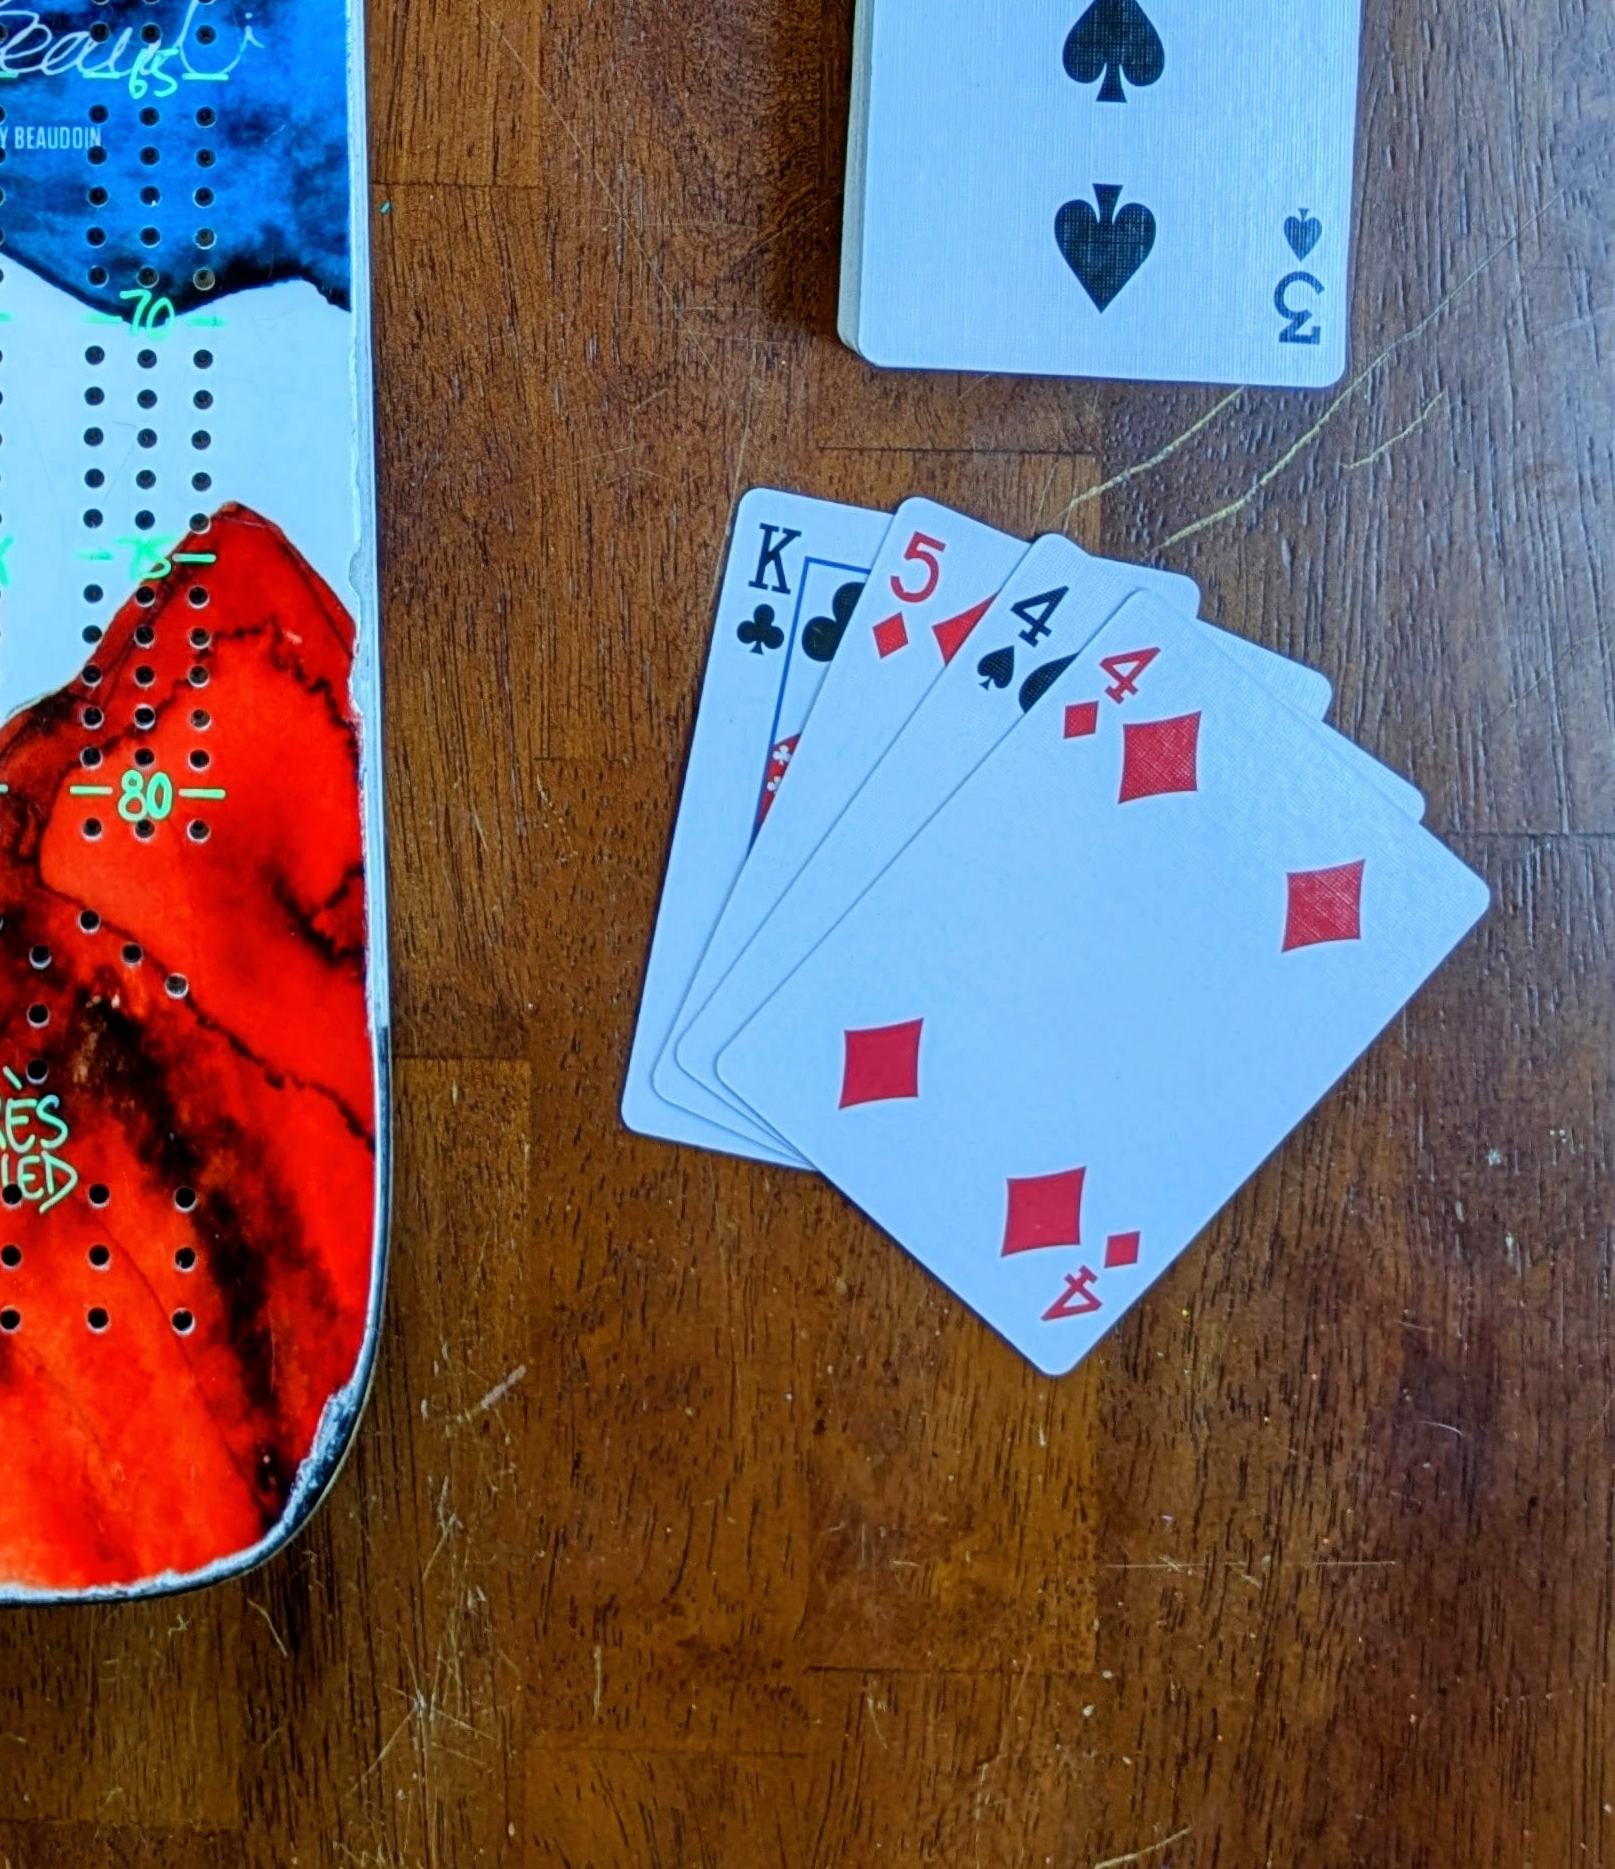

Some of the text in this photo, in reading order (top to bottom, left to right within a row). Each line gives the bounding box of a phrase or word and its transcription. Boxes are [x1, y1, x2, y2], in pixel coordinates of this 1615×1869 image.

[128, 47, 179, 100] 65
[14, 126, 102, 150] BEAUDOIN
[120, 289, 175, 342] 70
[1273, 270, 1325, 346] 3
[114, 533, 175, 582] 75
[747, 522, 802, 595] K
[889, 530, 947, 604] 5
[1010, 585, 1070, 648] 4
[1098, 646, 1161, 705] 4
[116, 770, 174, 823] 80
[1040, 1264, 1104, 1322] 4
